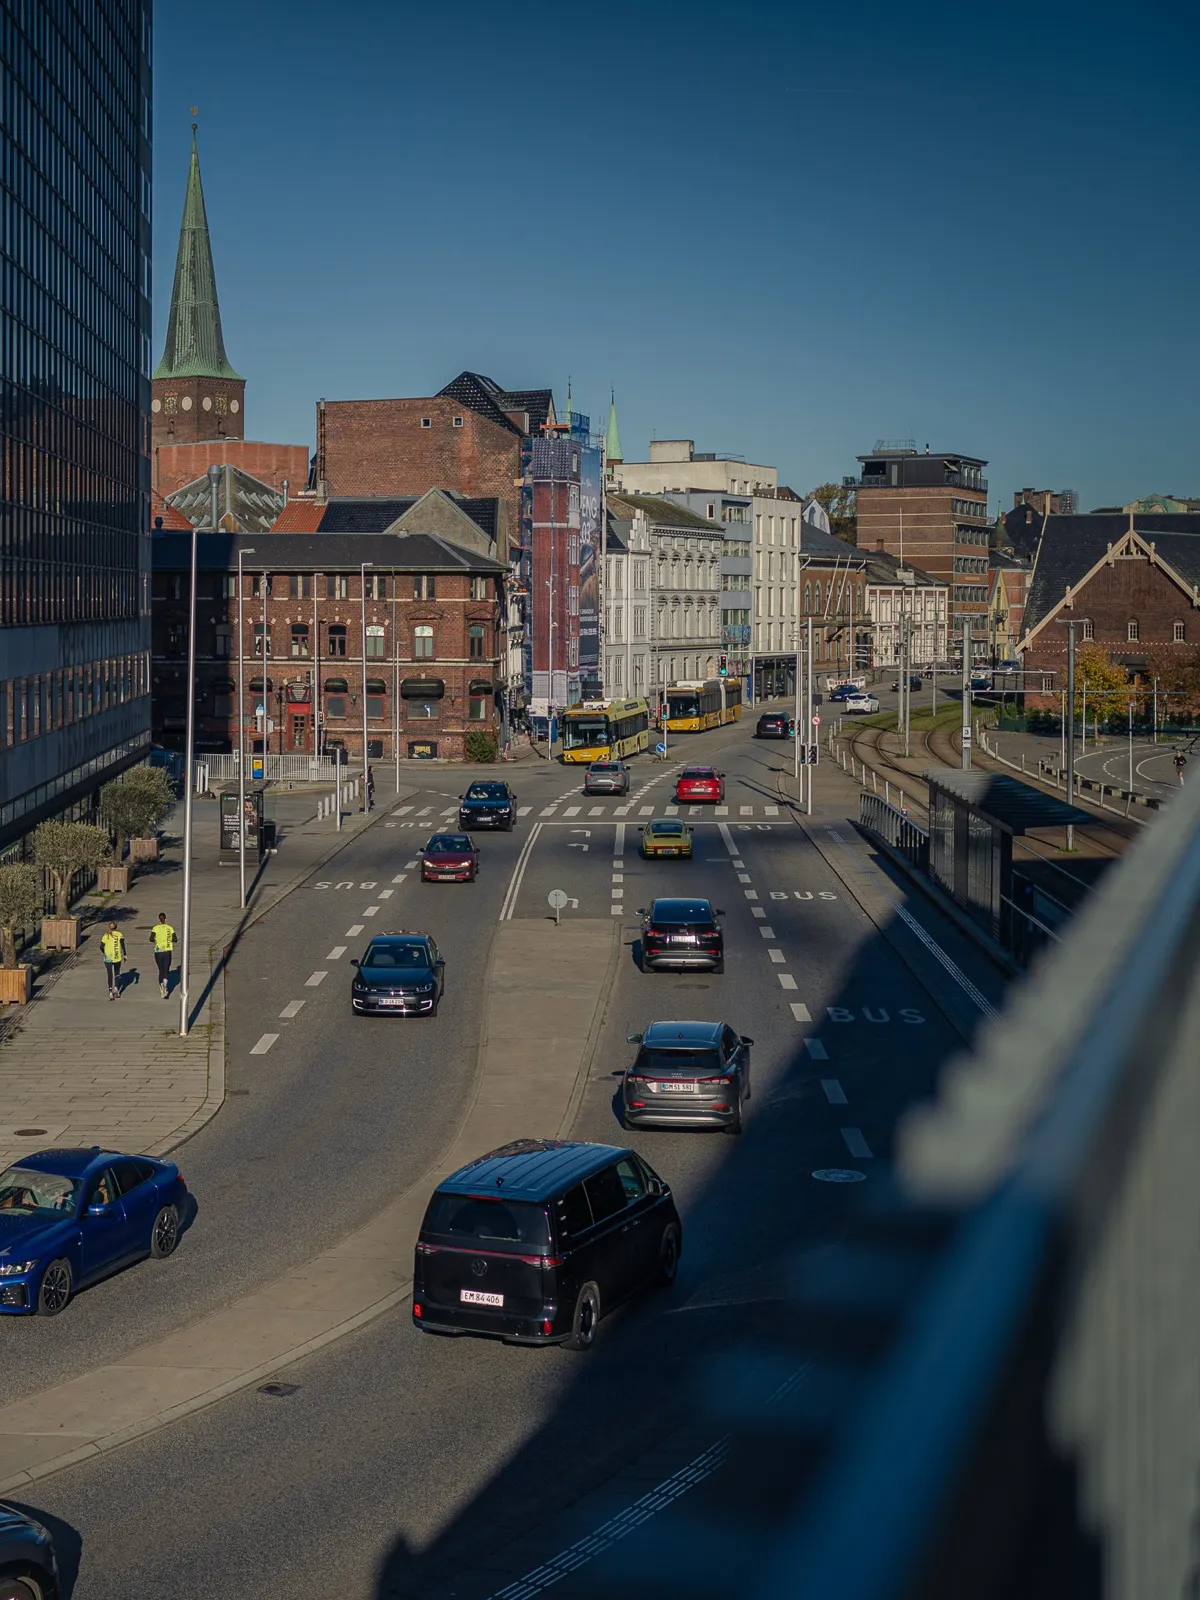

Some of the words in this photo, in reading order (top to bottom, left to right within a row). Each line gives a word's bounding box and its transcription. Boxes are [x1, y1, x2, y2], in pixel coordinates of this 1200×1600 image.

[313, 881, 378, 890] BUS
[769, 891, 838, 901] BUS
[826, 1006, 926, 1025] BUS
[464, 1292, 475, 1301] EM
[475, 1293, 485, 1302] 84
